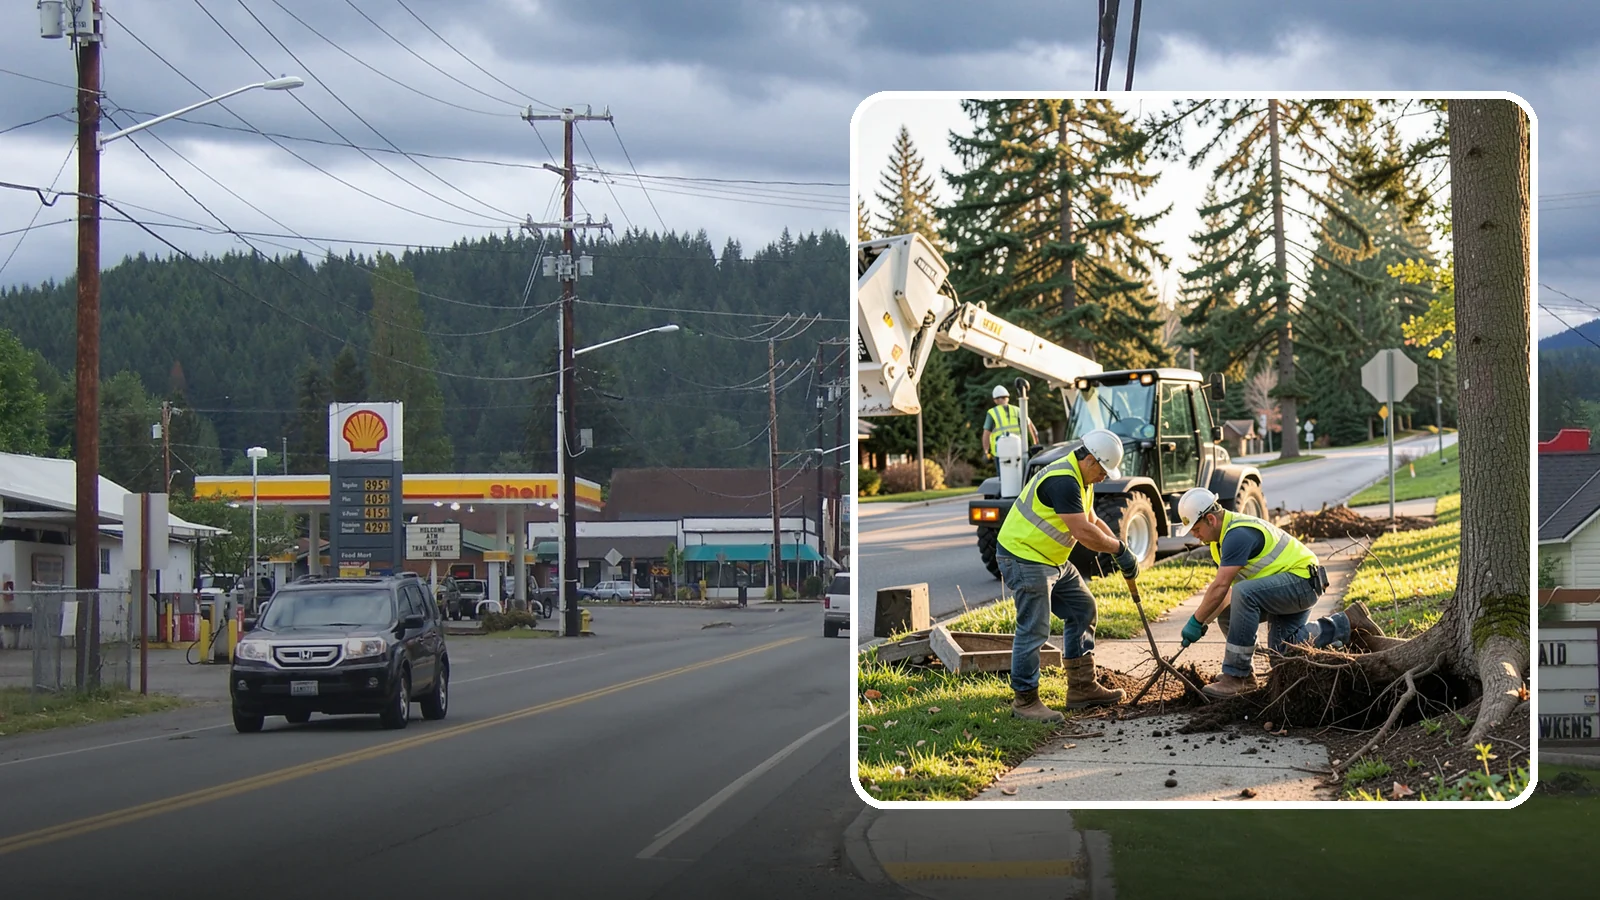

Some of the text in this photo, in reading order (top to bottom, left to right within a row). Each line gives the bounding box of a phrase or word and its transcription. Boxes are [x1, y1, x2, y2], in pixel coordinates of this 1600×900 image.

[366, 480, 384, 490] 395
[490, 484, 547, 498] Shell
[366, 494, 384, 504] 405
[366, 508, 383, 518] 415
[366, 522, 384, 533] 429
